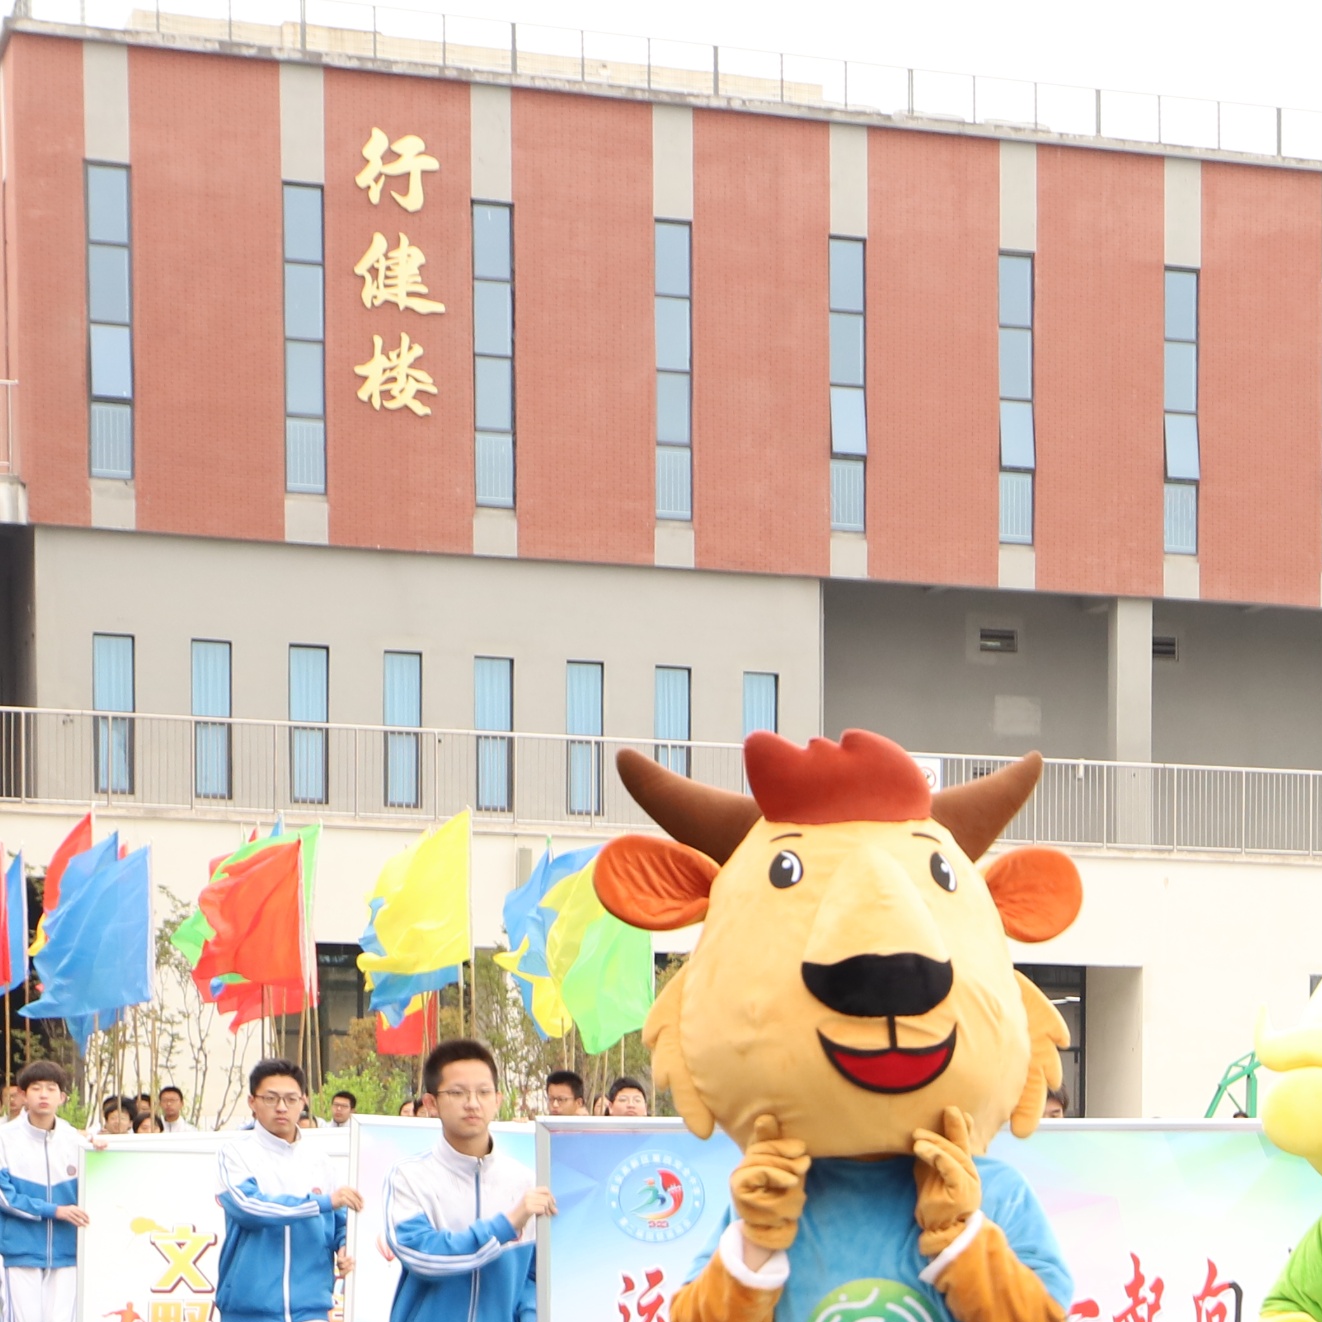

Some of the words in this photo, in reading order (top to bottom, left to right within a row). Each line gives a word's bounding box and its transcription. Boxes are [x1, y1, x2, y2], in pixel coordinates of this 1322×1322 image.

[355, 126, 446, 417] 行健楼
[150, 1224, 217, 1293] 文
